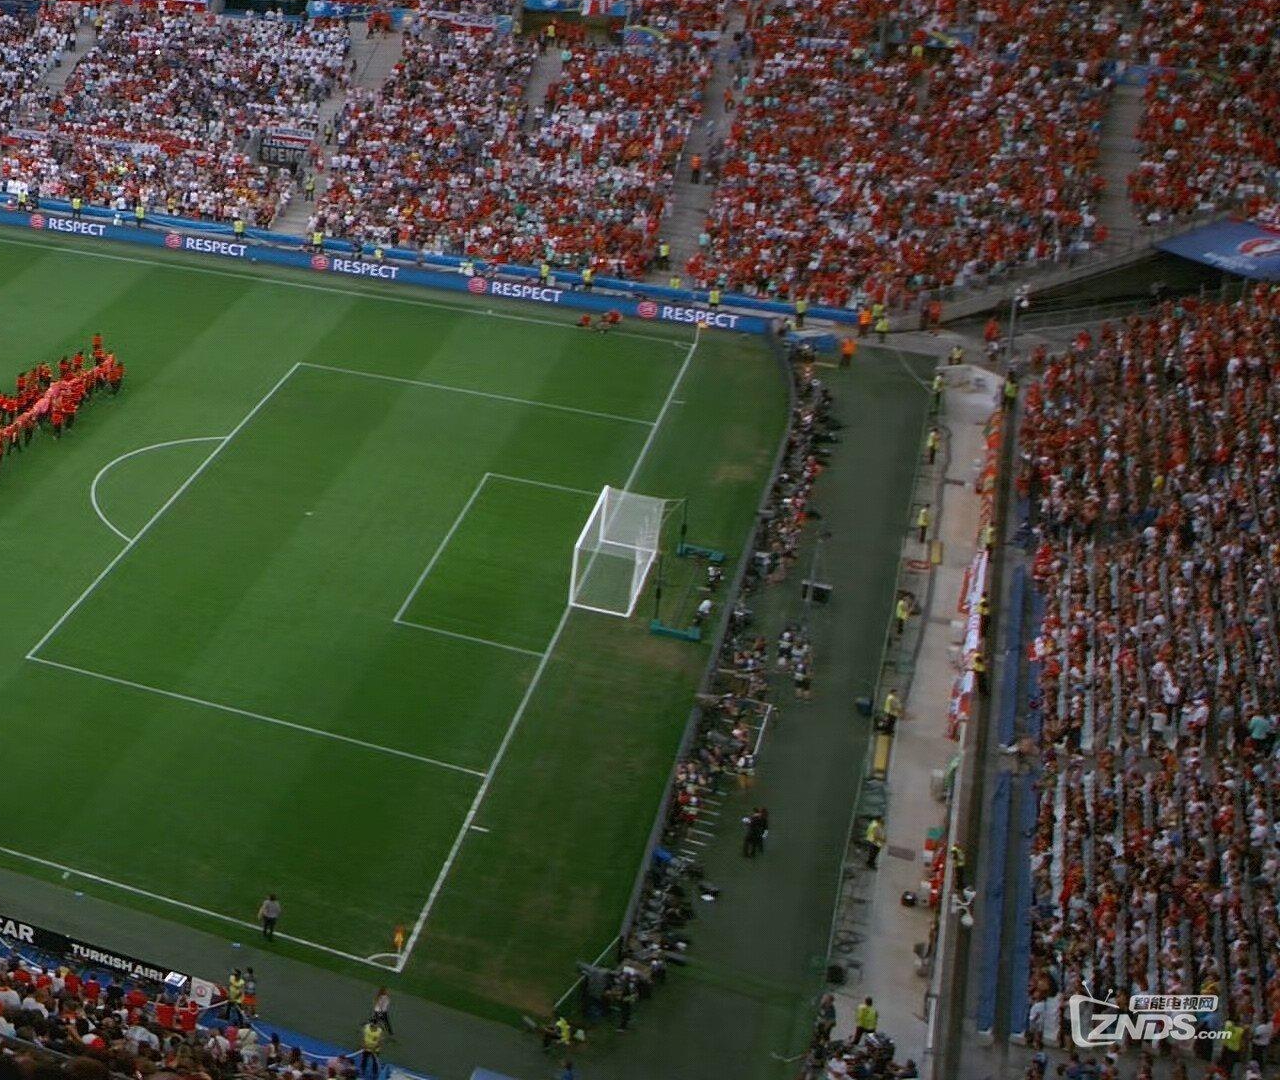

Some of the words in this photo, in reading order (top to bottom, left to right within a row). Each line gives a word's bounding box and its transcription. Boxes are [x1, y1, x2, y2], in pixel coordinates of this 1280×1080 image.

[48, 218, 106, 237] RESPECT
[185, 237, 247, 257] RESPECT
[333, 259, 400, 281] RESPECT
[492, 281, 563, 303] RESPECT
[663, 305, 739, 329] RESPECT
[71, 943, 134, 973] TURKISH
